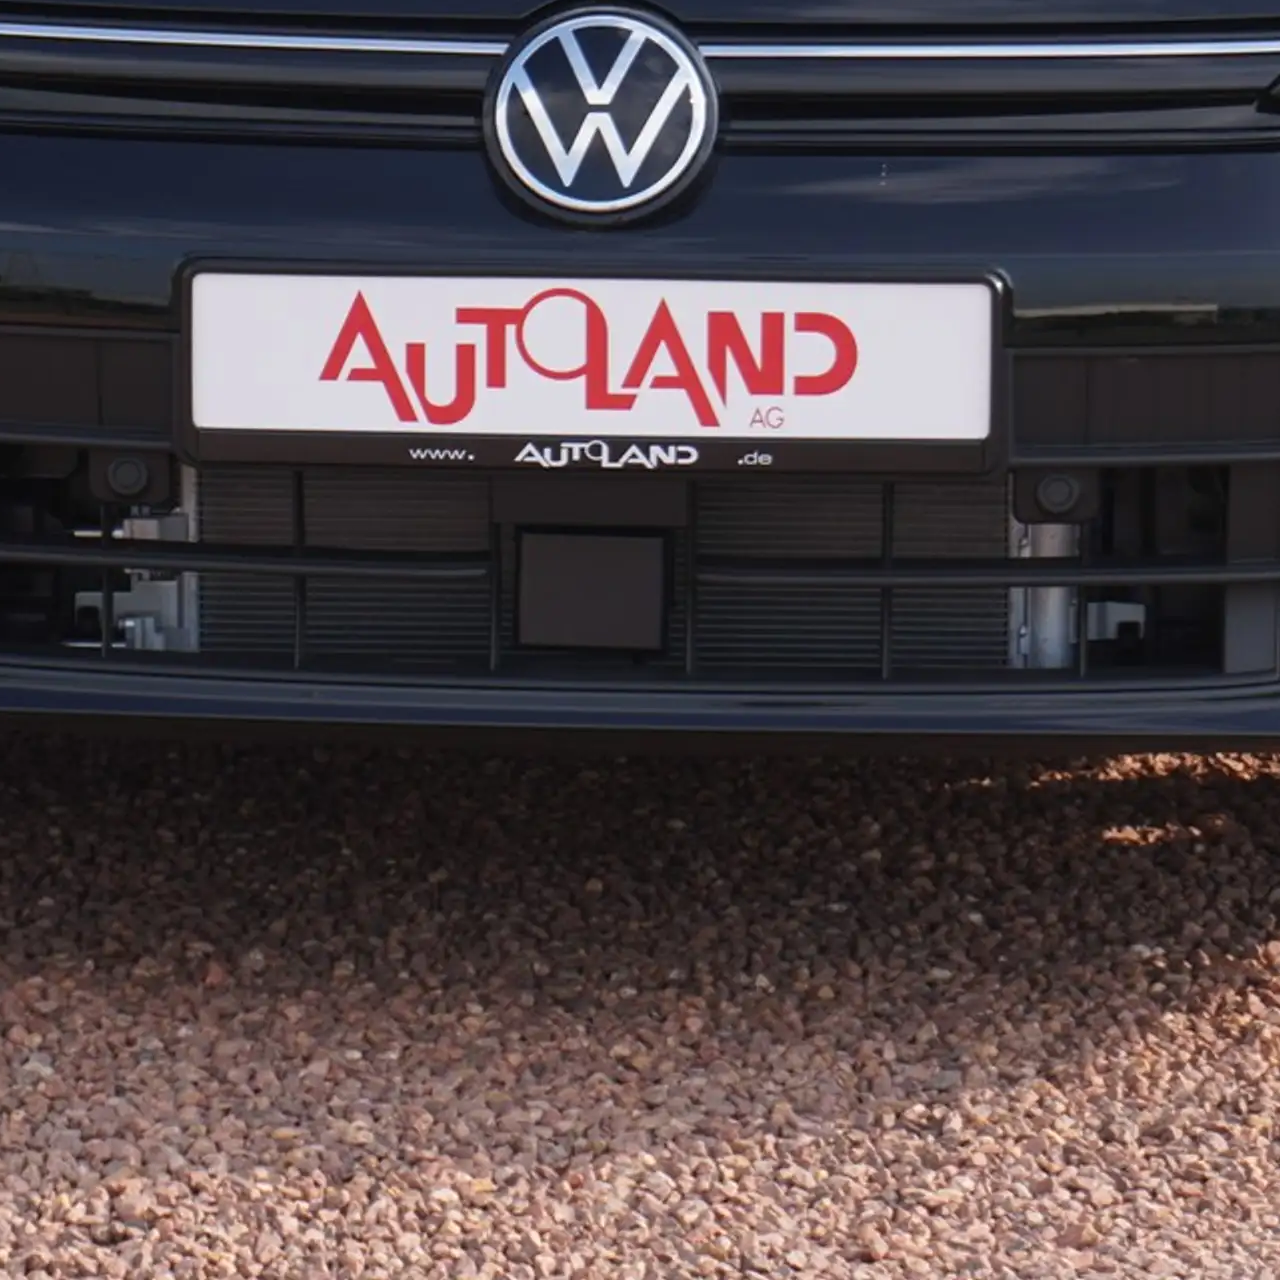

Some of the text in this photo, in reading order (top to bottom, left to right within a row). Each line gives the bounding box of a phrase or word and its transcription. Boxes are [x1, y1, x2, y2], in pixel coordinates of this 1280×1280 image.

[513, 20, 688, 187] VW
[318, 287, 858, 428] AUTOLAND
[409, 439, 774, 470] www. AUTOLAND .de
[749, 407, 786, 429] AG
